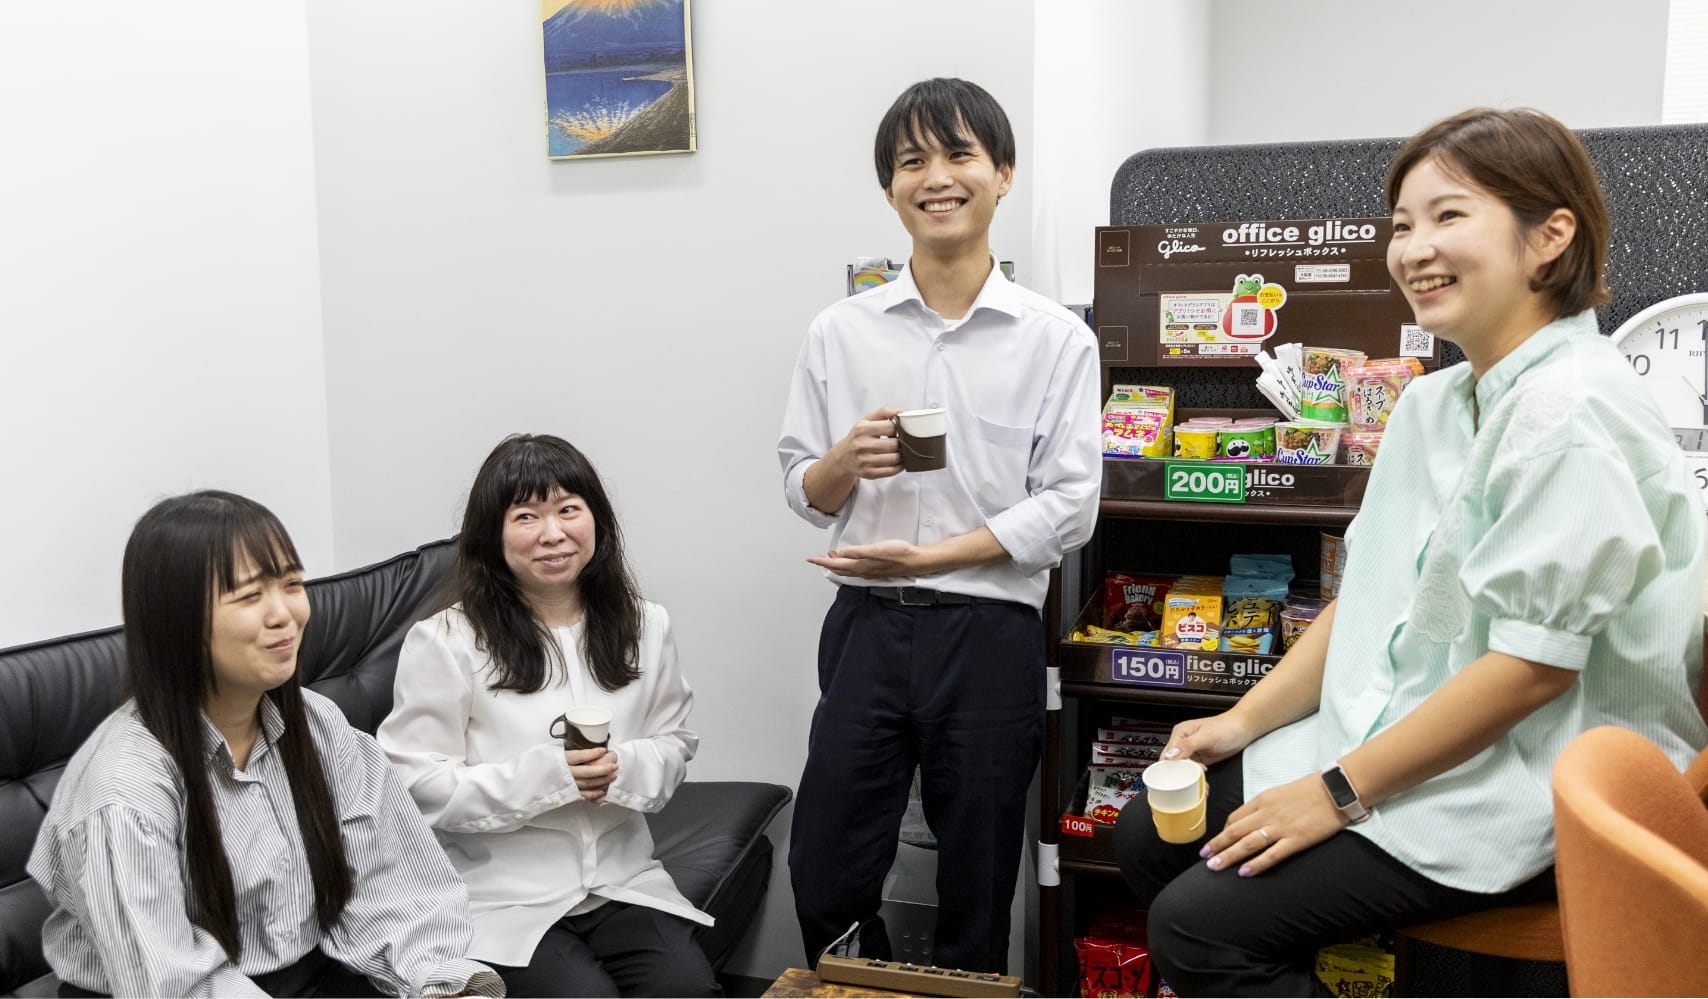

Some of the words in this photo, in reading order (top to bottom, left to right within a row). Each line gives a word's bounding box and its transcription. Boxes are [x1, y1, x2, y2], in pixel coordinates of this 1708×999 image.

[1222, 223, 1300, 243] office
[1308, 220, 1376, 246] glico
[1655, 328, 1679, 350] 11
[1313, 374, 1340, 392] Star
[1363, 387, 1375, 424] はるさめ
[1375, 385, 1386, 411] スープ
[1296, 449, 1321, 465] Star
[1122, 583, 1157, 597] Friend
[1125, 592, 1153, 604] Bakery
[1178, 623, 1204, 633] ビスコ
